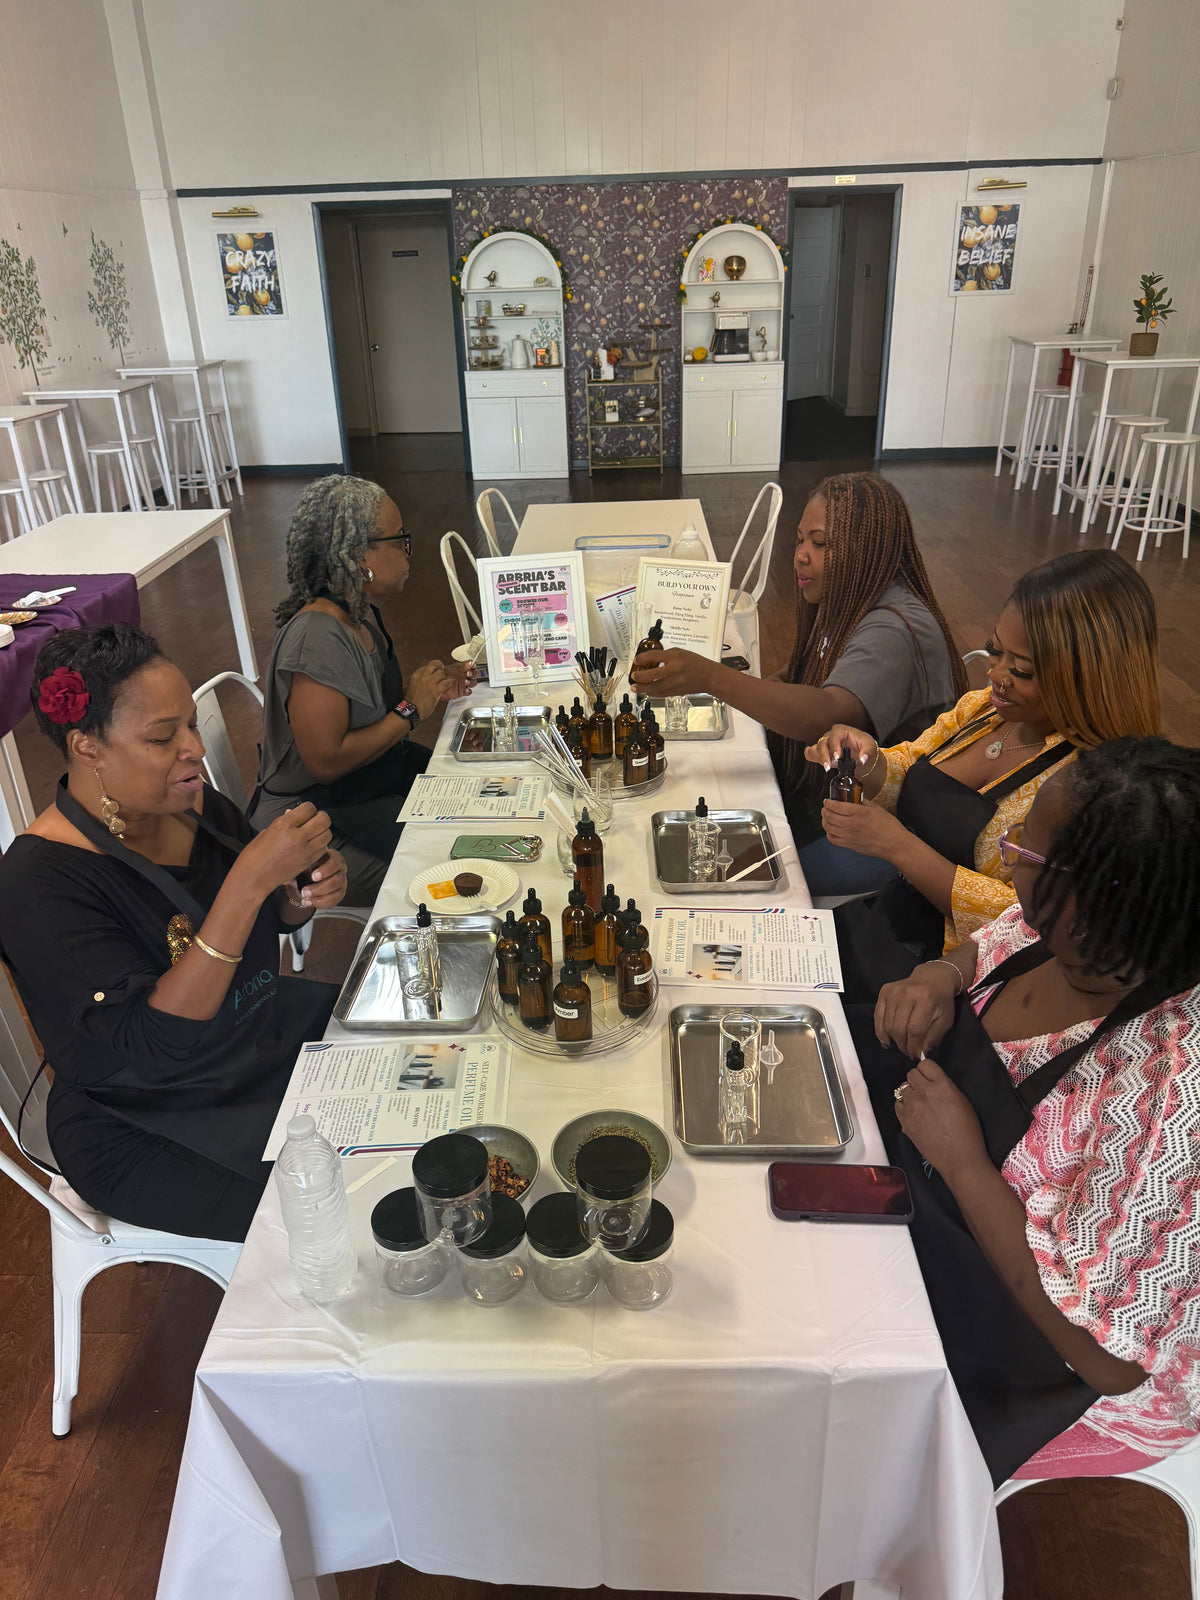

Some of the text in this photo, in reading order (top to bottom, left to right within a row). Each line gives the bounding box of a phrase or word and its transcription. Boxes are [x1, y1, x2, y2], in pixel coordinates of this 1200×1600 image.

[960, 223, 1017, 242] INSANE
[225, 249, 274, 269] CRAZY
[958, 248, 1013, 266] BELIEF
[231, 274, 275, 293] FAITH
[497, 570, 556, 584] ARBRIA'S
[540, 580, 567, 592] BAR
[657, 580, 717, 592] BUILD YOUR OWN
[498, 582, 539, 595] SCENT
[674, 919, 687, 963] PERFUME OIL
[479, 1060, 490, 1092] SELF-CARE
[459, 1062, 479, 1125] PERFUME OIL
